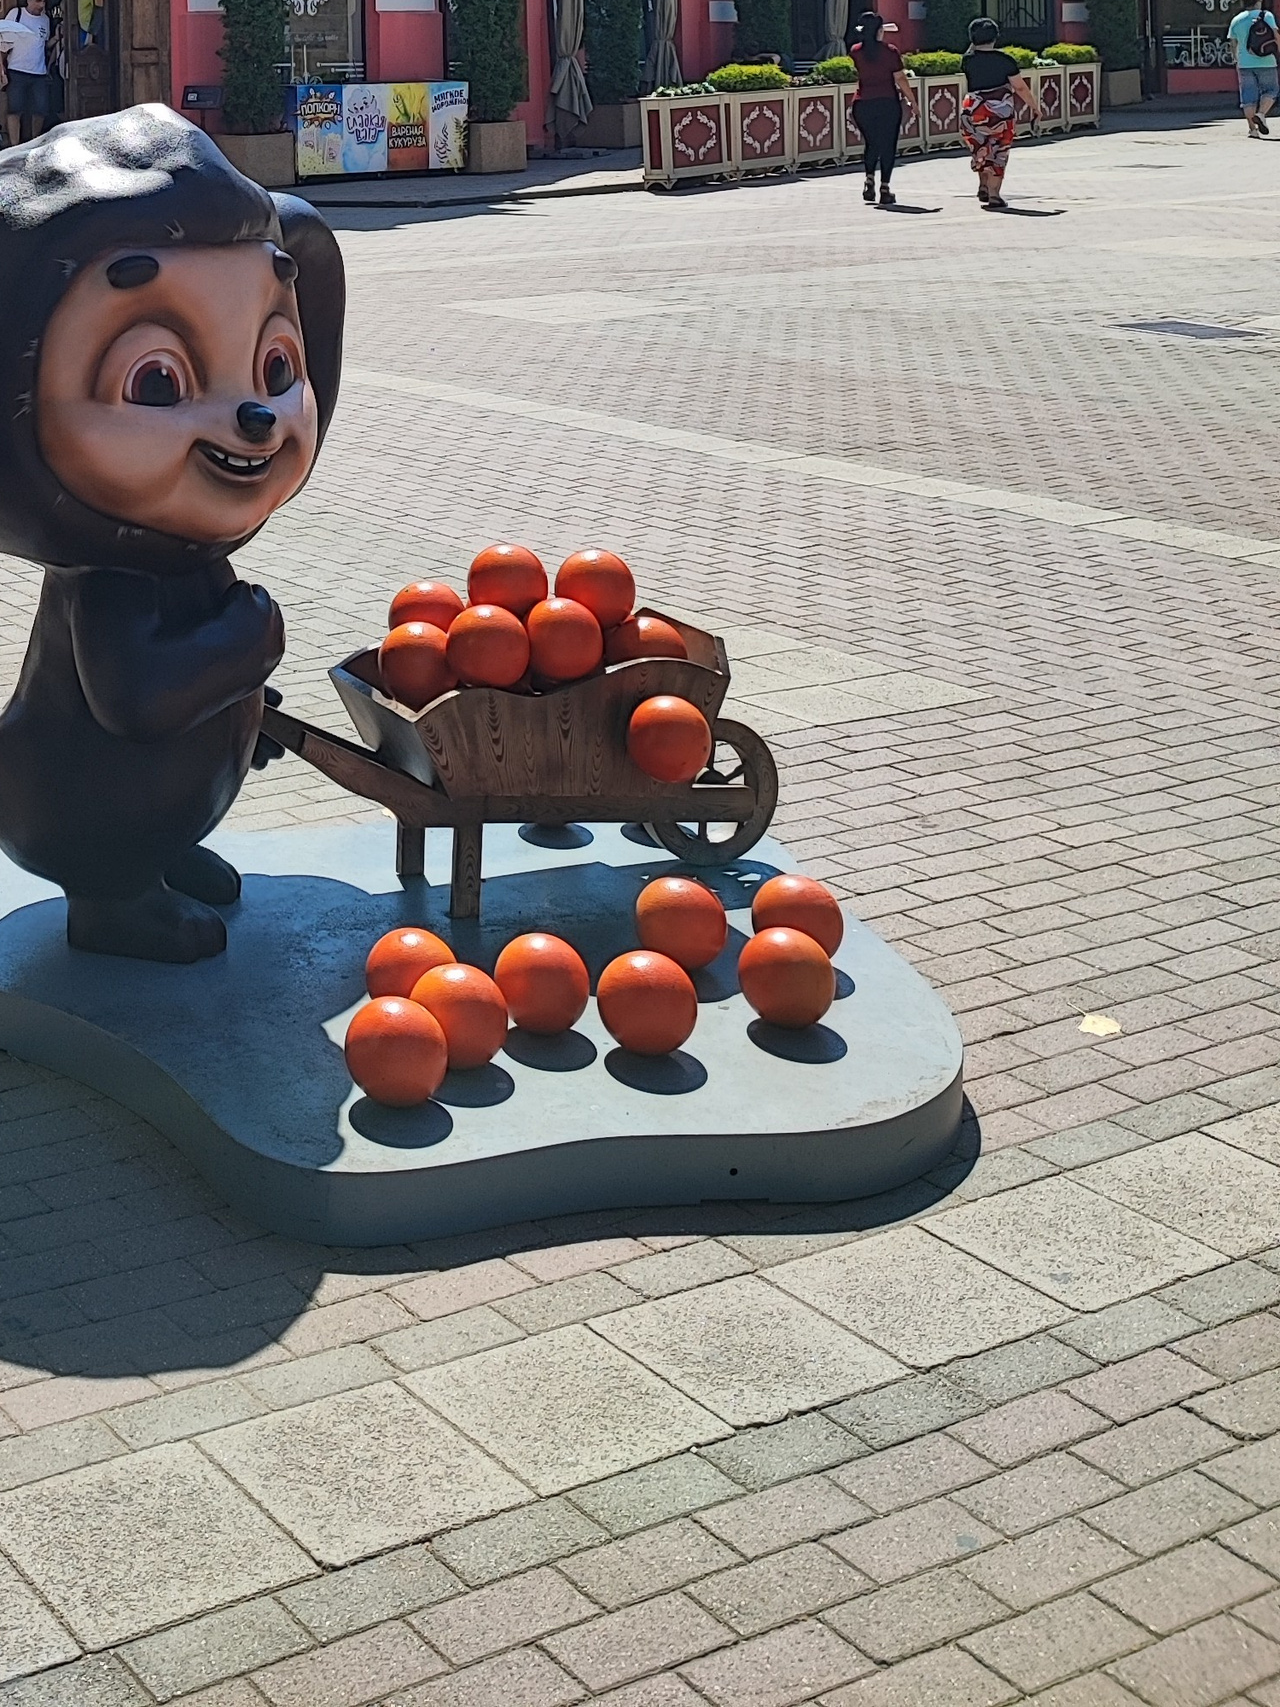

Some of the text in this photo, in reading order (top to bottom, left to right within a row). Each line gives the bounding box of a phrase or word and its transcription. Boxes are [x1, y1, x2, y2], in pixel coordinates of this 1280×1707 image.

[434, 89, 465, 103] МЯГКОЕ
[300, 103, 340, 116] ПОПКОРН
[391, 125, 424, 136] ВАРЕНАЯ
[388, 136, 427, 148] КУКУРУЗА
